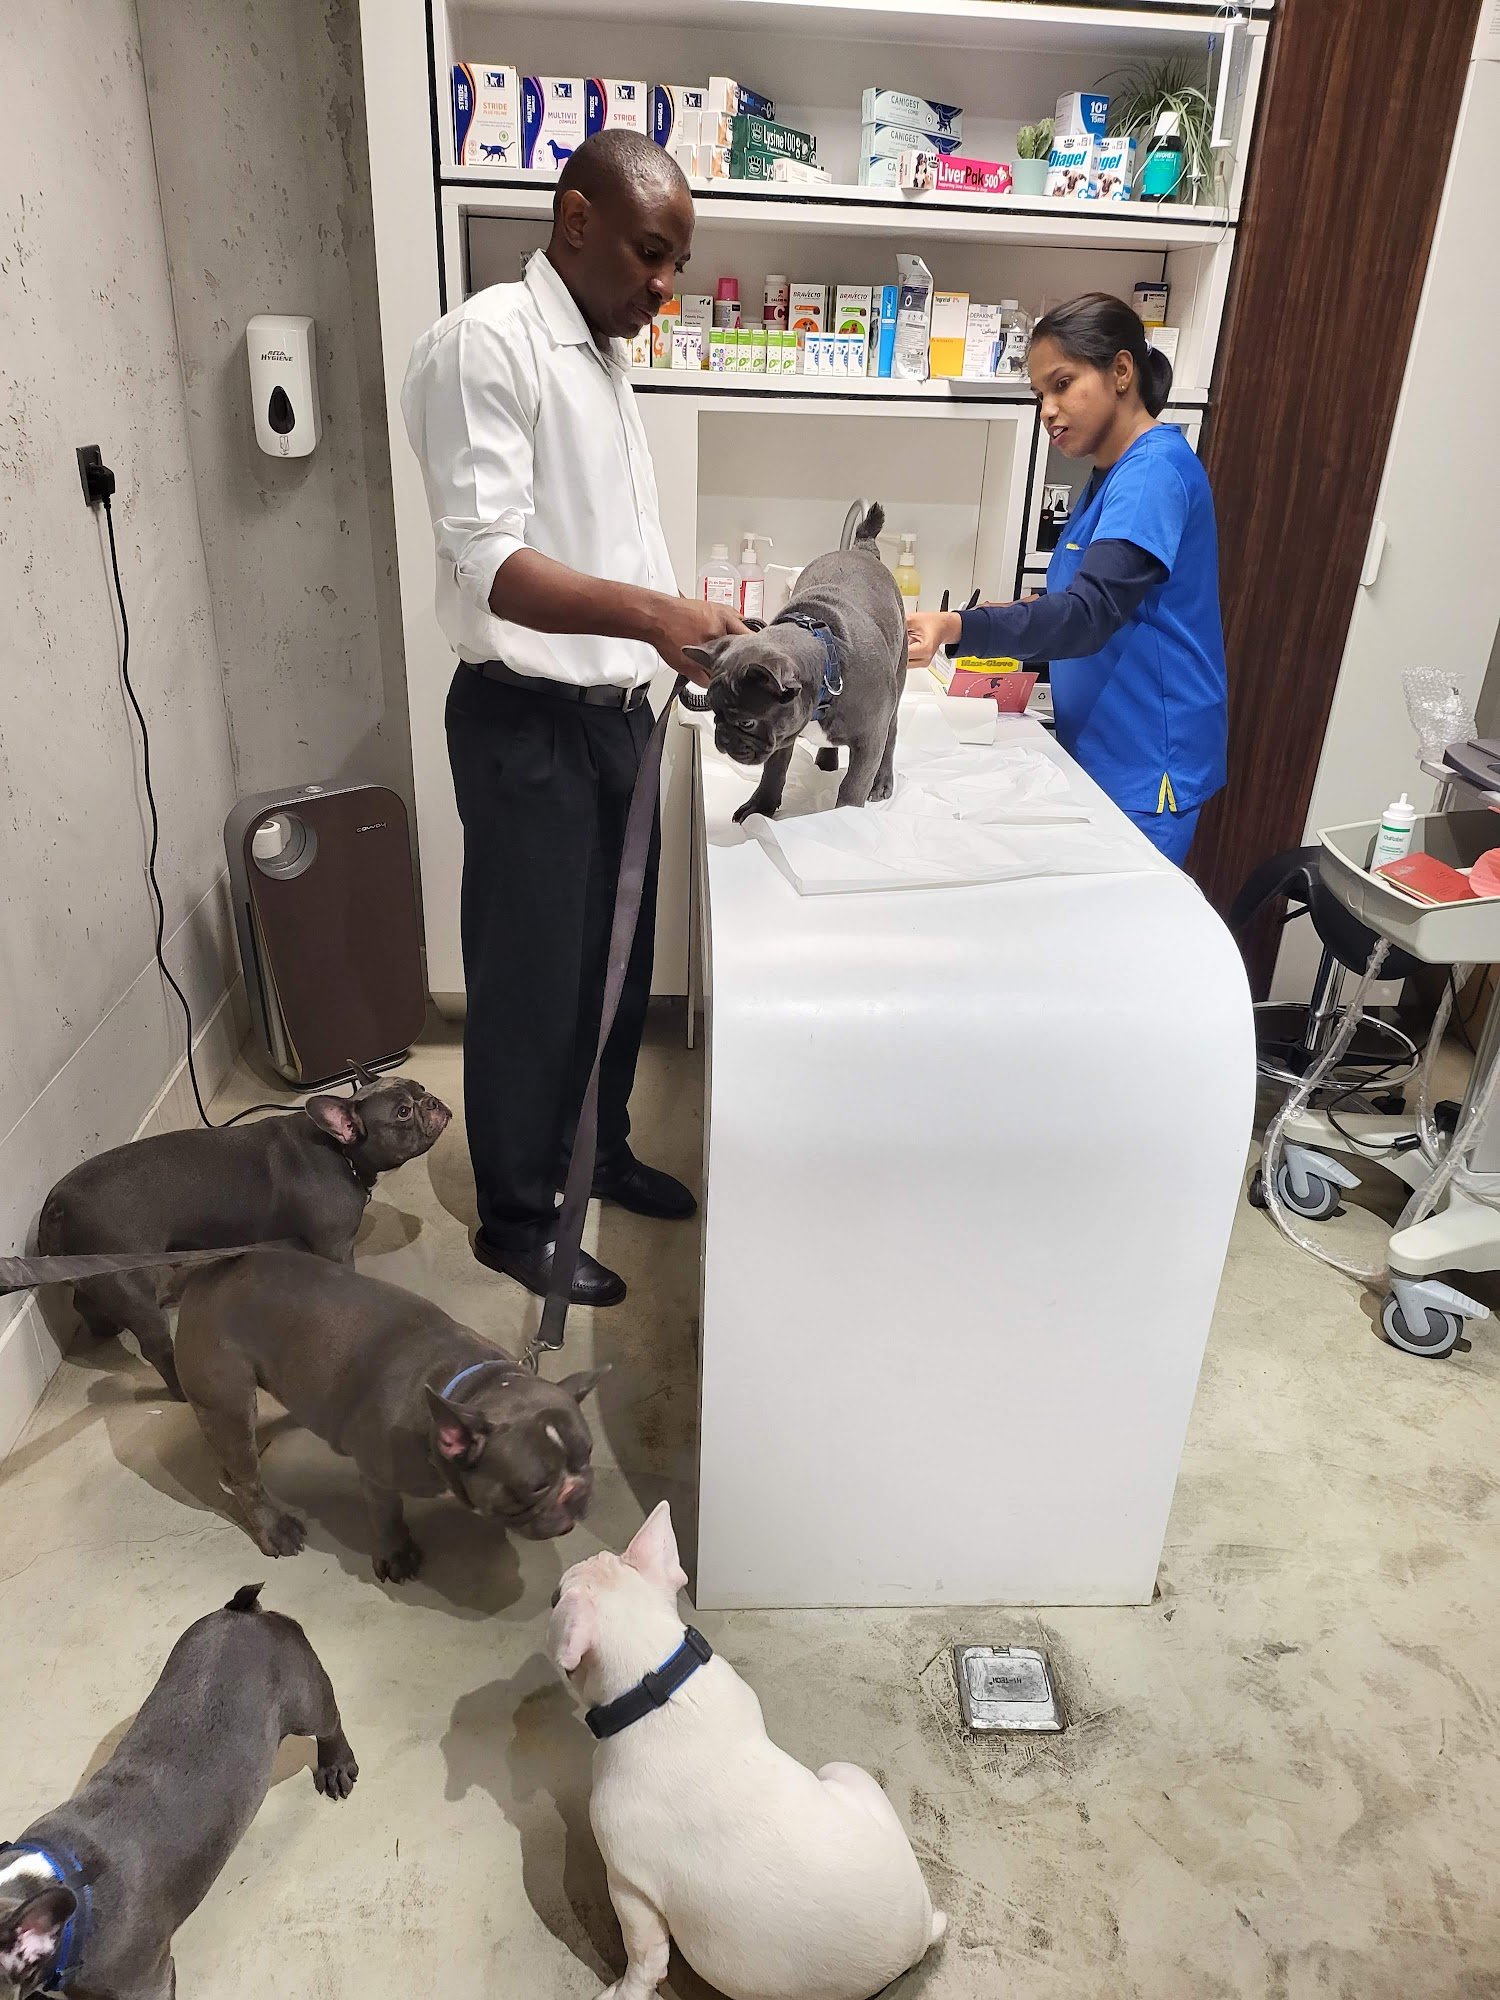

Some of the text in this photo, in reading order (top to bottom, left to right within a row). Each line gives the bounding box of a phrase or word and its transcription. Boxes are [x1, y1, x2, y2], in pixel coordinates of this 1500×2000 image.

[482, 102, 508, 110] STRIDE
[890, 95, 920, 109] CANIGEST
[613, 114, 637, 122] STRIDE
[890, 130, 919, 144] CANIGEST
[1049, 150, 1087, 168] Diagel
[793, 289, 821, 299] BRAVECTO
[839, 291, 868, 300] BRAVECTO
